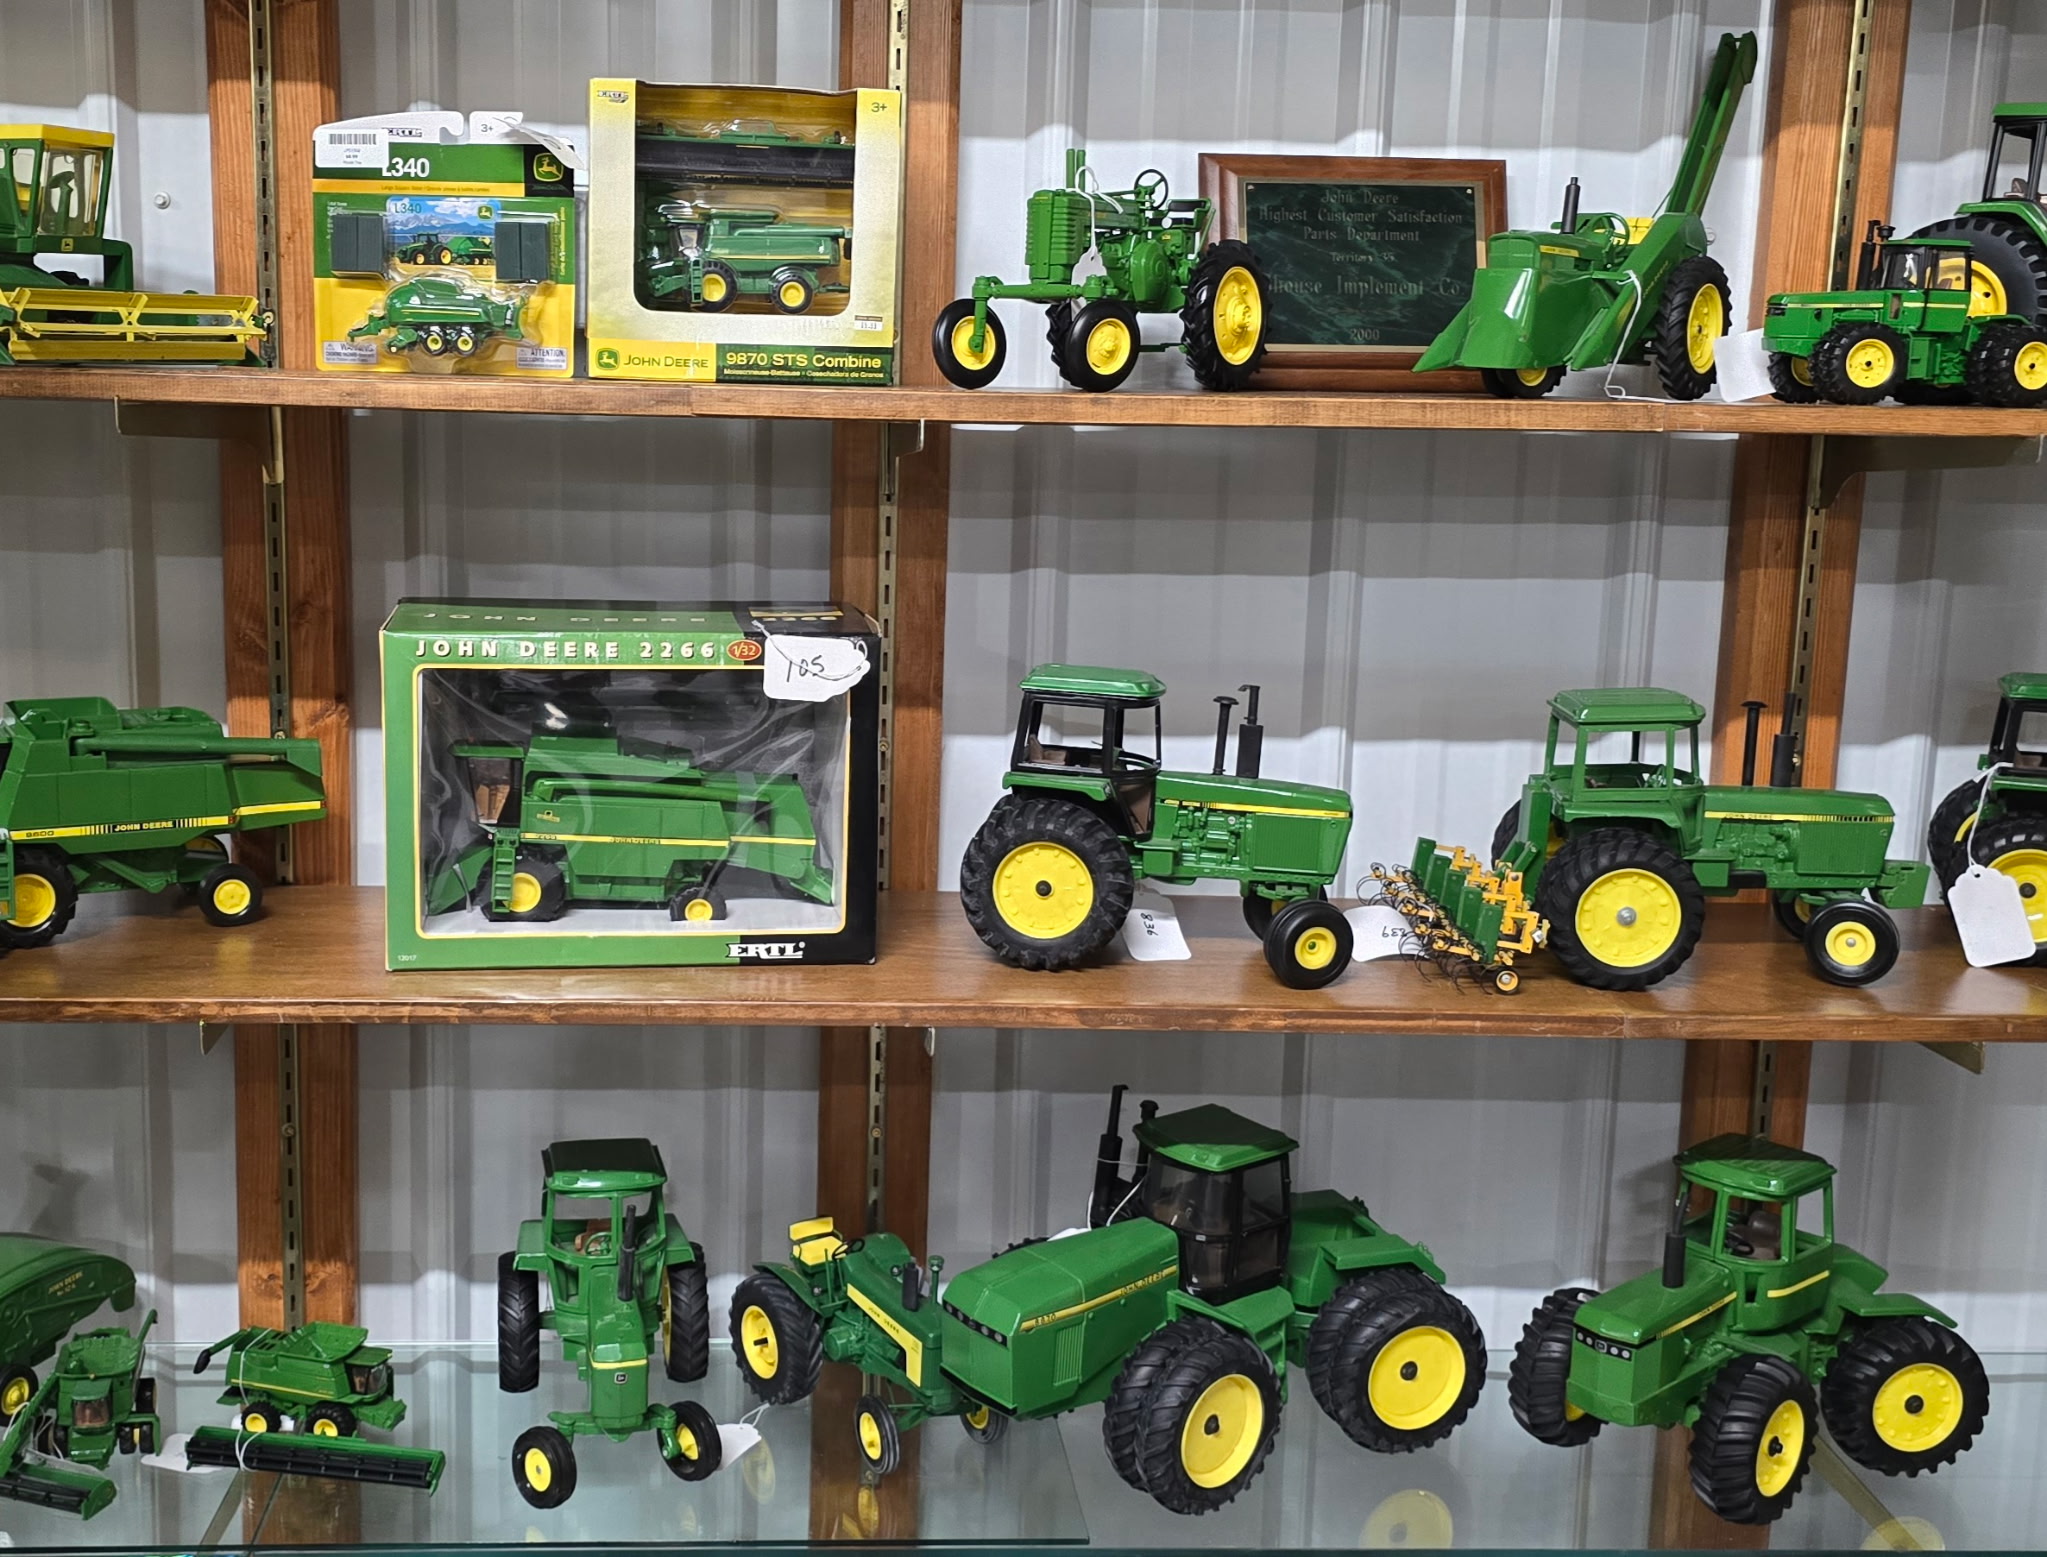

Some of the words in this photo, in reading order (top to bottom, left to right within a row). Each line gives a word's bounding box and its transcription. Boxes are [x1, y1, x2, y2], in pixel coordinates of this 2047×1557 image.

[871, 102, 887, 112] 3+
[481, 124, 493, 133] 3+
[1321, 190, 1353, 204] John
[1363, 190, 1399, 204] Deere
[394, 203, 422, 214] L340
[1259, 208, 1307, 224] Highest
[1318, 209, 1378, 223] Customer
[1388, 209, 1463, 224] Satisfaction
[1303, 226, 1337, 240] Parts
[1347, 226, 1420, 242] Department
[1331, 252, 1374, 264] Territory
[1336, 275, 1424, 299] Implement
[1350, 328, 1380, 341] 2000
[624, 355, 660, 366] JOHN
[664, 356, 708, 368] DEERE
[726, 352, 768, 366] 9870
[772, 353, 808, 367] STS
[812, 353, 882, 369] Combine
[416, 640, 499, 657] JOHN
[519, 640, 619, 658] DEERE
[639, 641, 715, 659] 2266
[733, 642, 756, 657] 1/32
[114, 823, 141, 832] JOHN
[142, 821, 174, 831] DEERE
[1140, 912, 1159, 936] 836
[726, 943, 803, 960] ERTL
